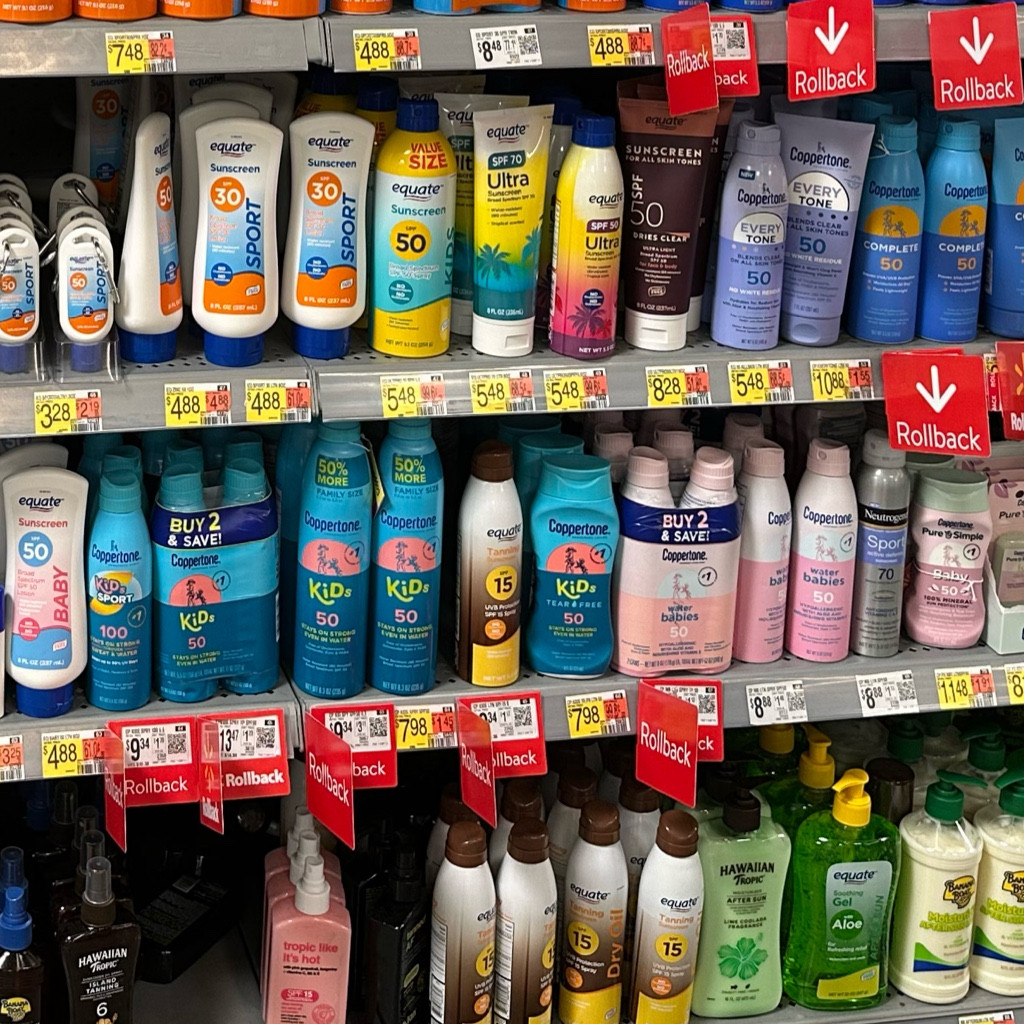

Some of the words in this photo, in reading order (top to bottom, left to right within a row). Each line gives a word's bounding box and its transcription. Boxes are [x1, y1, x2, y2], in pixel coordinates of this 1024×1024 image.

[795, 64, 867, 94] Rollback
[941, 79, 1014, 103] Rollback
[626, 145, 702, 157] SUNSCREEN
[493, 157, 508, 166] SPF
[511, 155, 522, 164] 70
[210, 164, 260, 174] Sunscreen
[488, 173, 529, 188] Ultra
[214, 188, 241, 204] 30
[793, 183, 842, 198] EVERY
[799, 197, 832, 209] TONE
[633, 233, 658, 242] DRIES
[660, 234, 687, 242] CLEAR
[864, 241, 918, 253] COMPLETE
[897, 424, 982, 451] Rollback
[318, 459, 348, 476] 50%
[318, 474, 348, 487] MORE
[549, 519, 611, 537] Coppertone
[868, 534, 904, 550] Sport
[952, 532, 983, 541] Simple
[171, 553, 221, 570] Coppertone
[810, 566, 839, 578] water
[803, 573, 845, 586] babies
[54, 566, 68, 623] BABY
[98, 593, 133, 604] SPORT
[813, 591, 834, 604] 50
[547, 600, 570, 608] TEAR
[580, 600, 601, 608] FREE
[640, 726, 692, 769] Rollback
[124, 778, 188, 795] Rollback
[720, 862, 774, 877] HAWAIIAN
[834, 870, 876, 883] equate
[727, 895, 750, 903] AFTER
[752, 895, 766, 903] SUN
[833, 897, 852, 907] Gel
[832, 918, 863, 930] Aloe
[284, 942, 316, 954] tropic
[320, 942, 338, 953] like
[78, 948, 127, 970] HAWAIIAN
[283, 954, 300, 965] it's
[302, 954, 320, 964] hot
